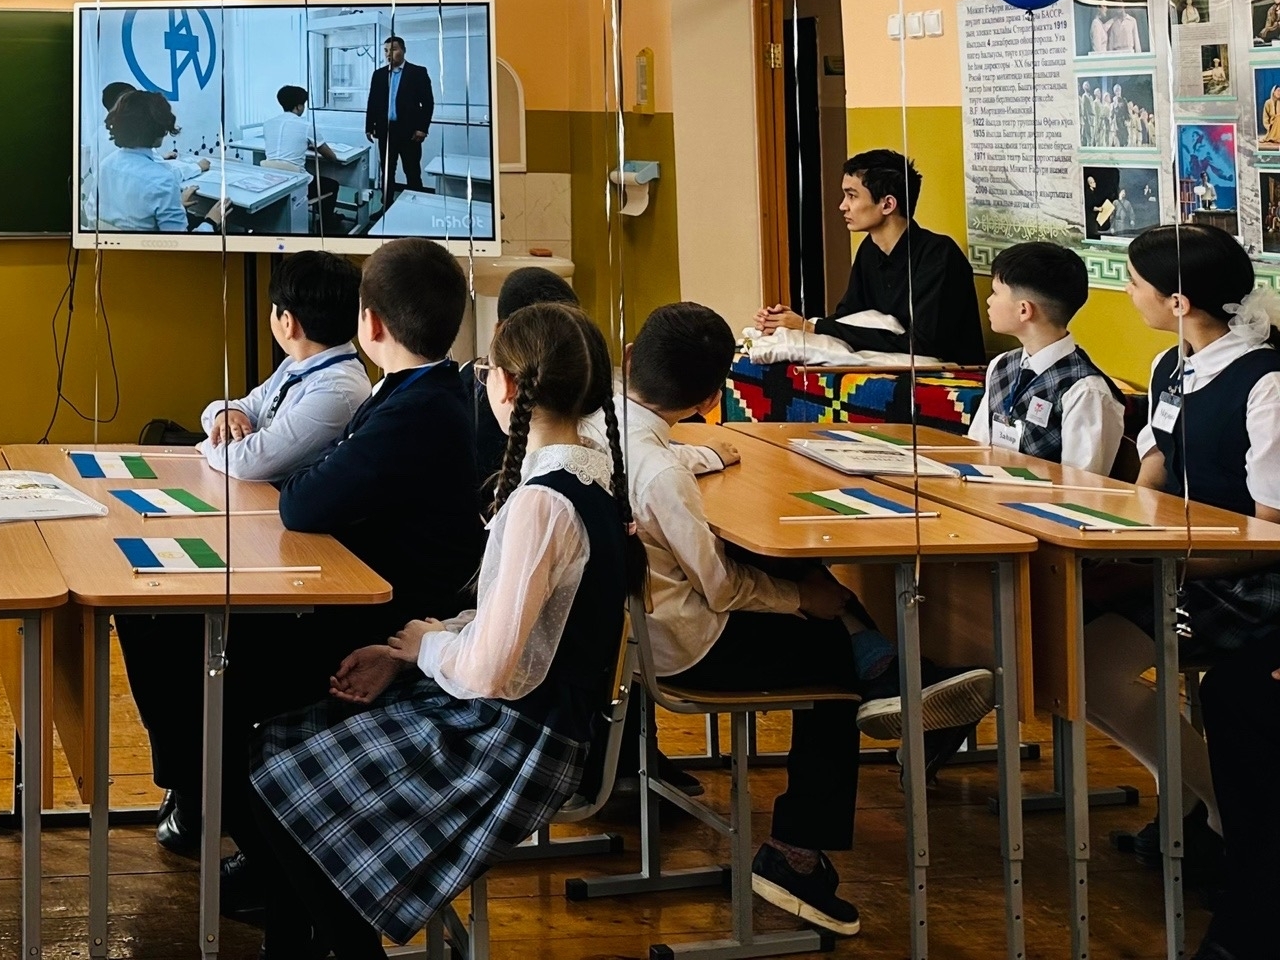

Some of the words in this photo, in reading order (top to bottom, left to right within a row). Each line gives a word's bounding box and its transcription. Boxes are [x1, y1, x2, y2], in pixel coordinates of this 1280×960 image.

[1054, 21, 1067, 30] 1919
[972, 118, 984, 126] 1922
[973, 130, 986, 138] 1935
[974, 152, 986, 160] 1971
